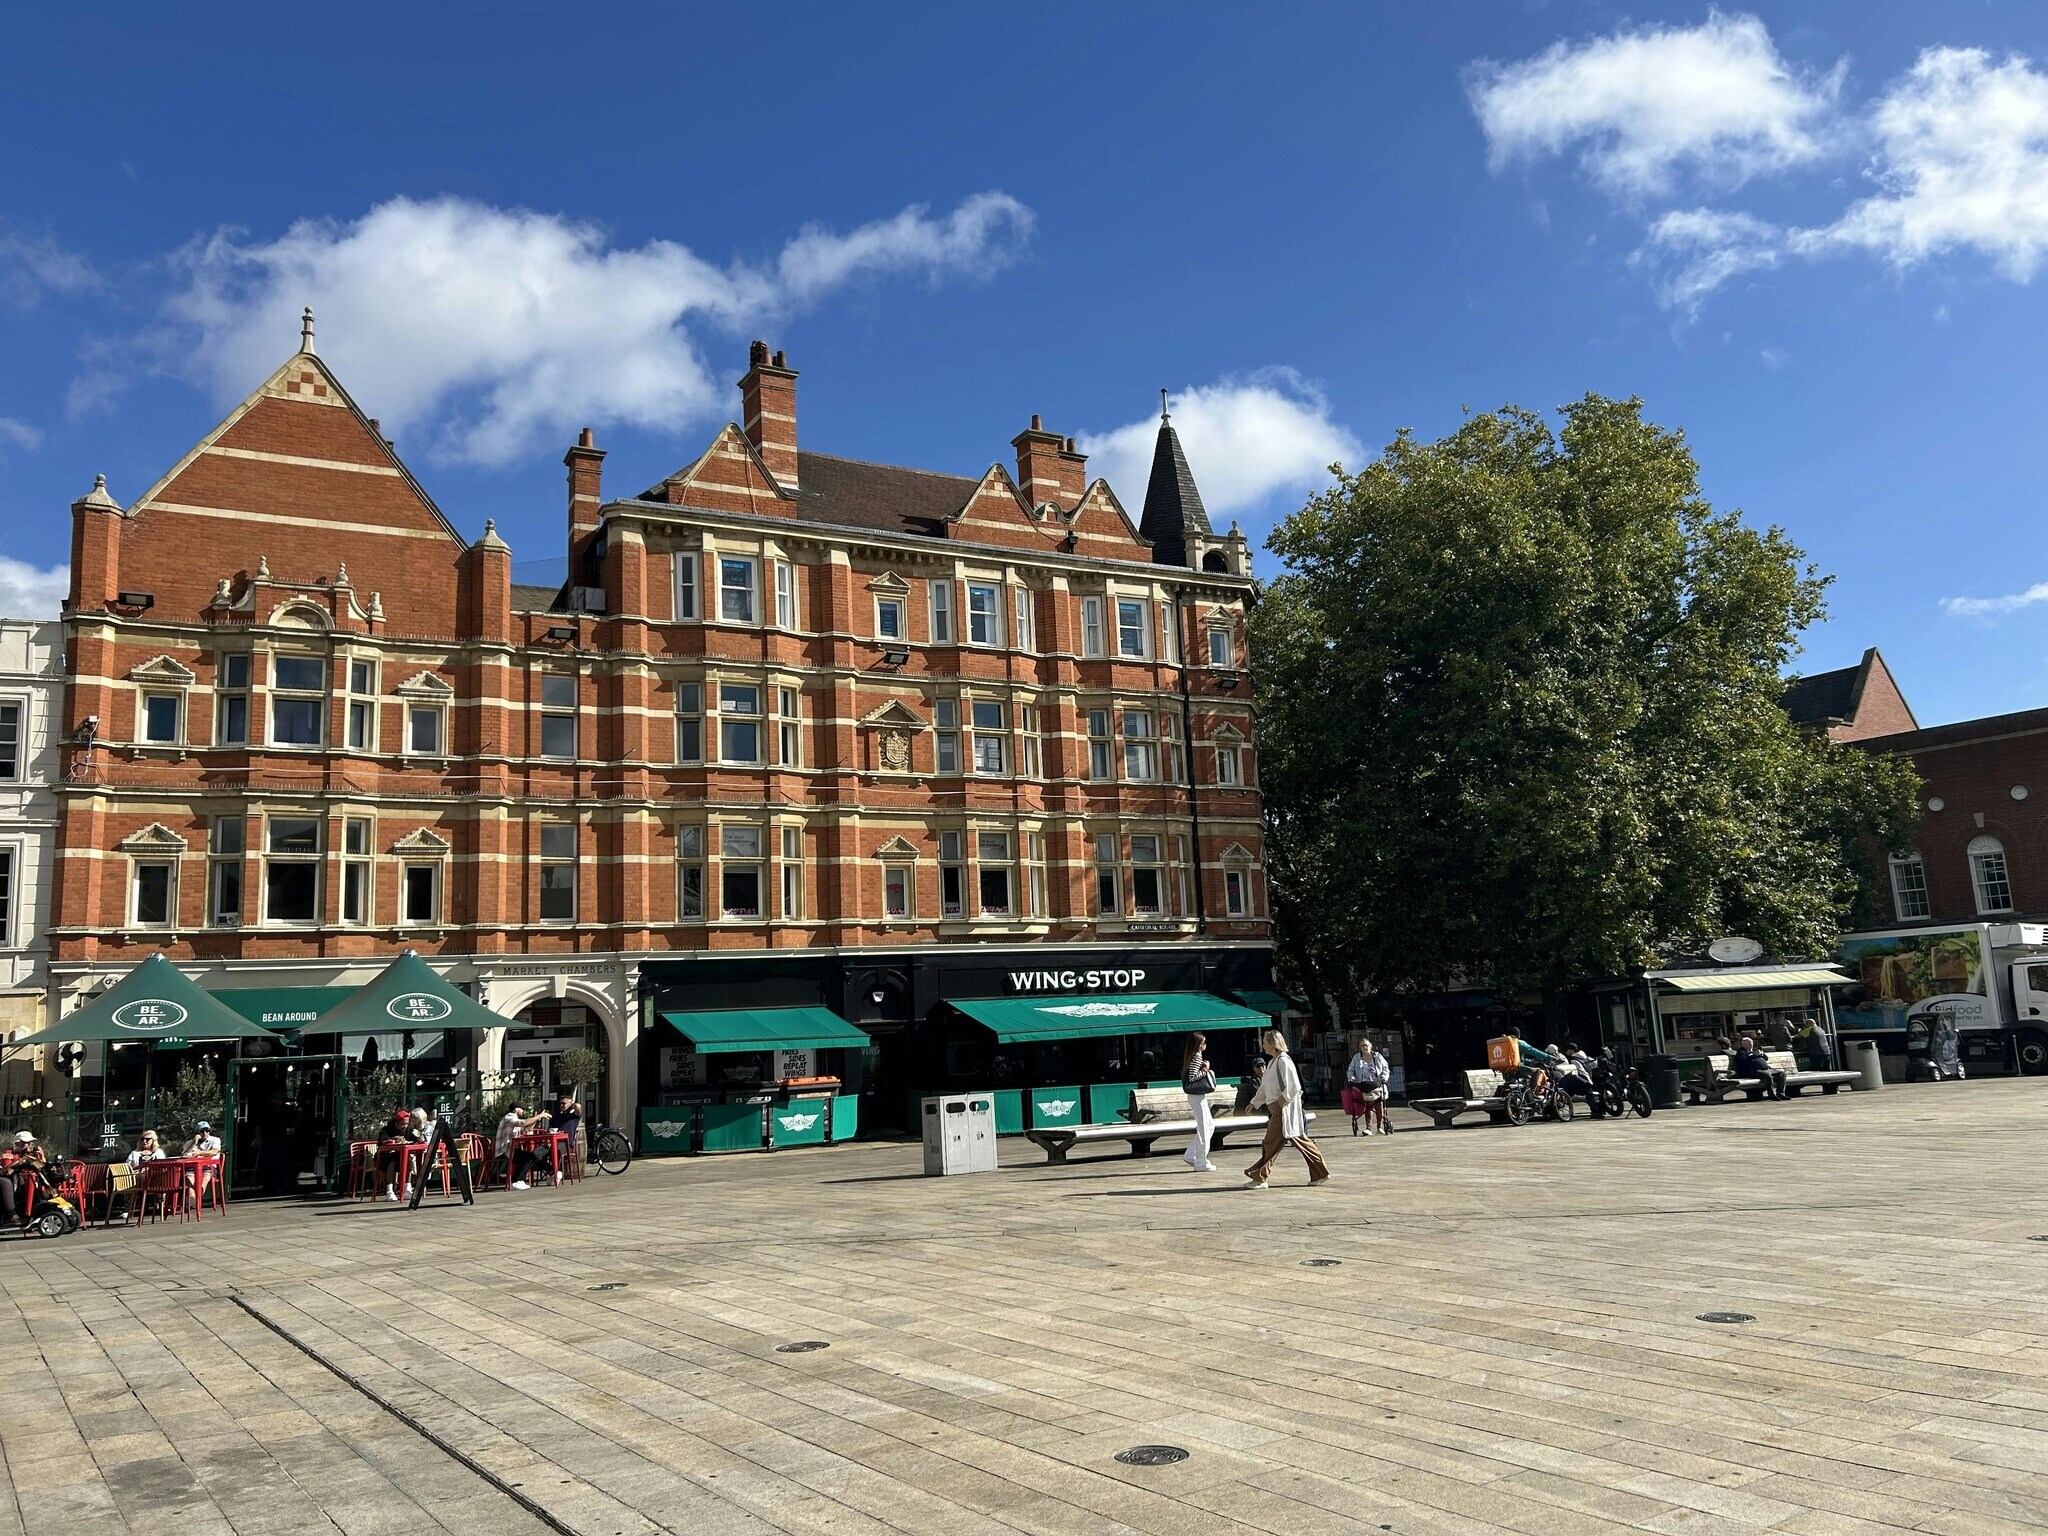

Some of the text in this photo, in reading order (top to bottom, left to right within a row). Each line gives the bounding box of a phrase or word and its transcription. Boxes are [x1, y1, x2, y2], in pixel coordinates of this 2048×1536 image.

[503, 965, 616, 975] MARKET CHAMBERS
[409, 998, 430, 1007] BE.
[140, 1005, 164, 1014] BE.
[411, 1009, 434, 1017] AR.
[138, 1016, 164, 1025] AR.
[262, 1011, 317, 1023] BEAN AROUND
[783, 1062, 807, 1070] REPEAT
[670, 1069, 697, 1077] REPEAT
[440, 1102, 453, 1112] BE.
[104, 1123, 119, 1134] BE.
[103, 1137, 119, 1148] AR.
